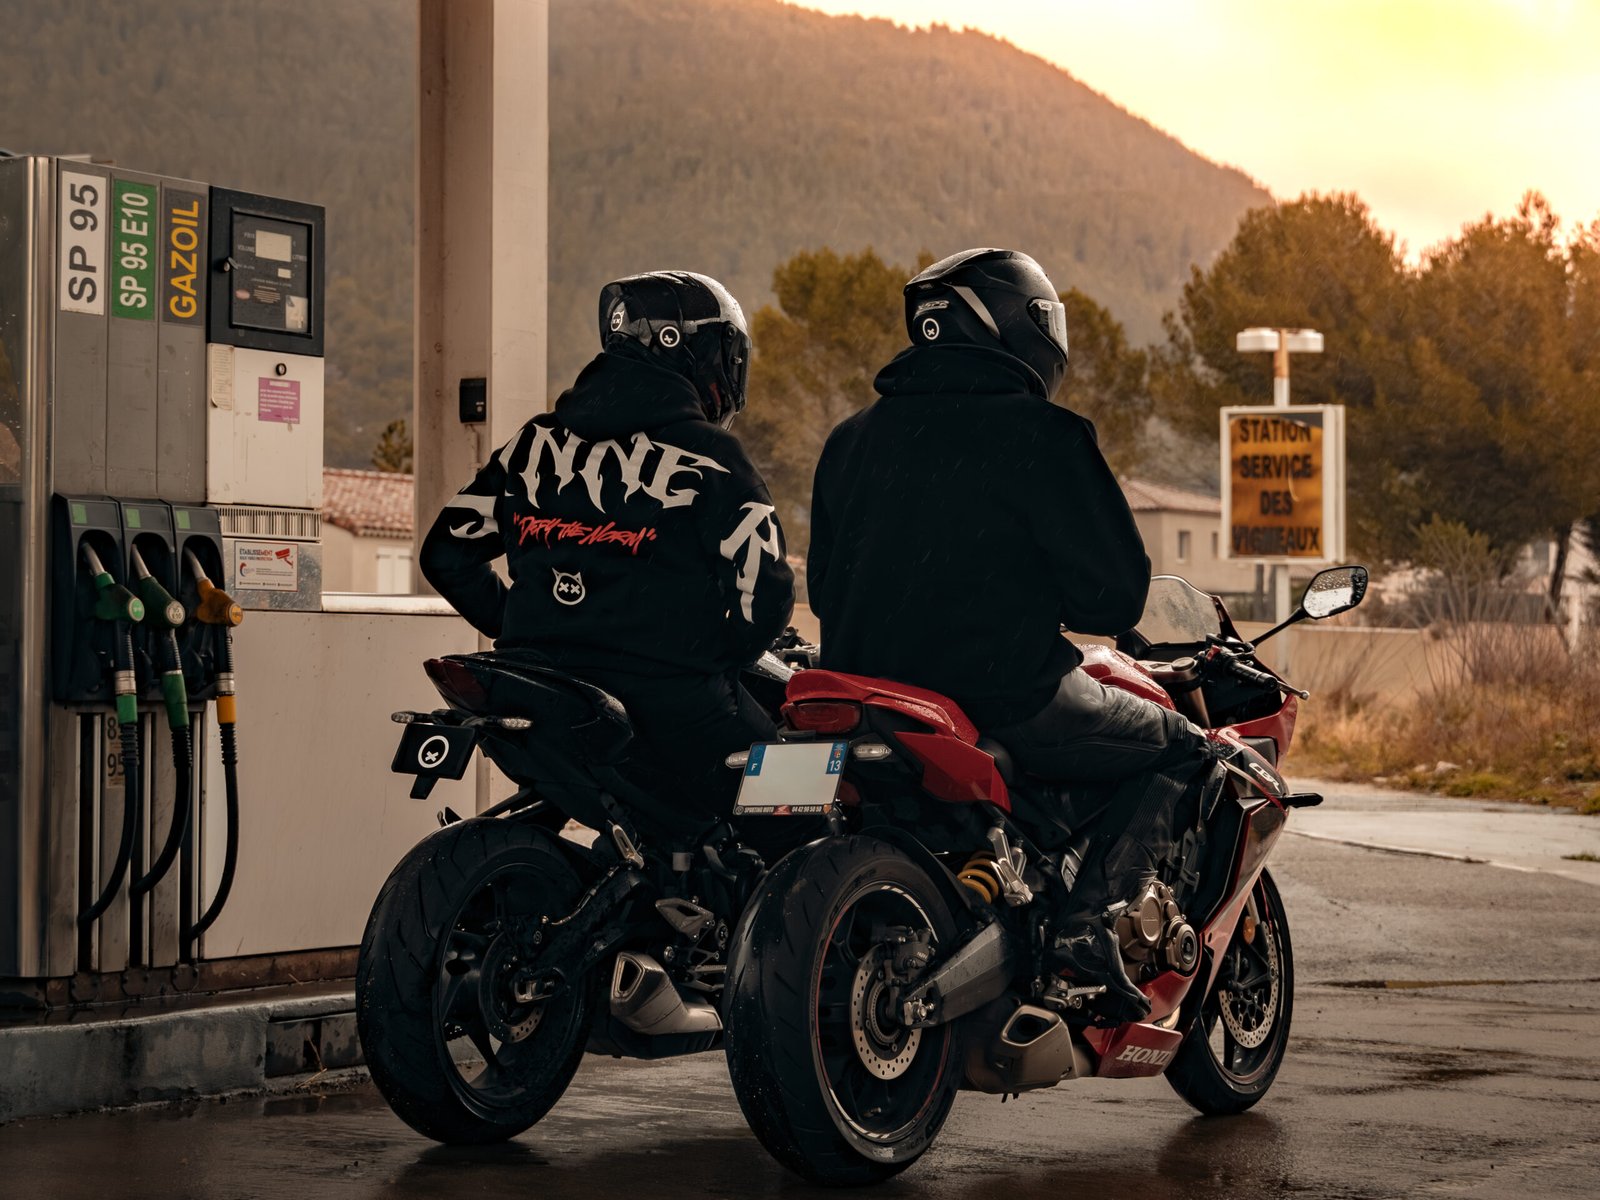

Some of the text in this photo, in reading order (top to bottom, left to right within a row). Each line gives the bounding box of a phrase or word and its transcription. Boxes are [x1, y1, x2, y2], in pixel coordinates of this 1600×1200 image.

[67, 183, 99, 303] SP 95
[119, 192, 149, 309] SP 95 E10
[169, 200, 199, 319] GAZOIL
[1239, 418, 1312, 442] STATION
[1240, 454, 1313, 479] SERVICE
[1260, 490, 1293, 515] DES
[107, 753, 126, 777] 95
[751, 763, 758, 771] F
[829, 760, 841, 772] 13
